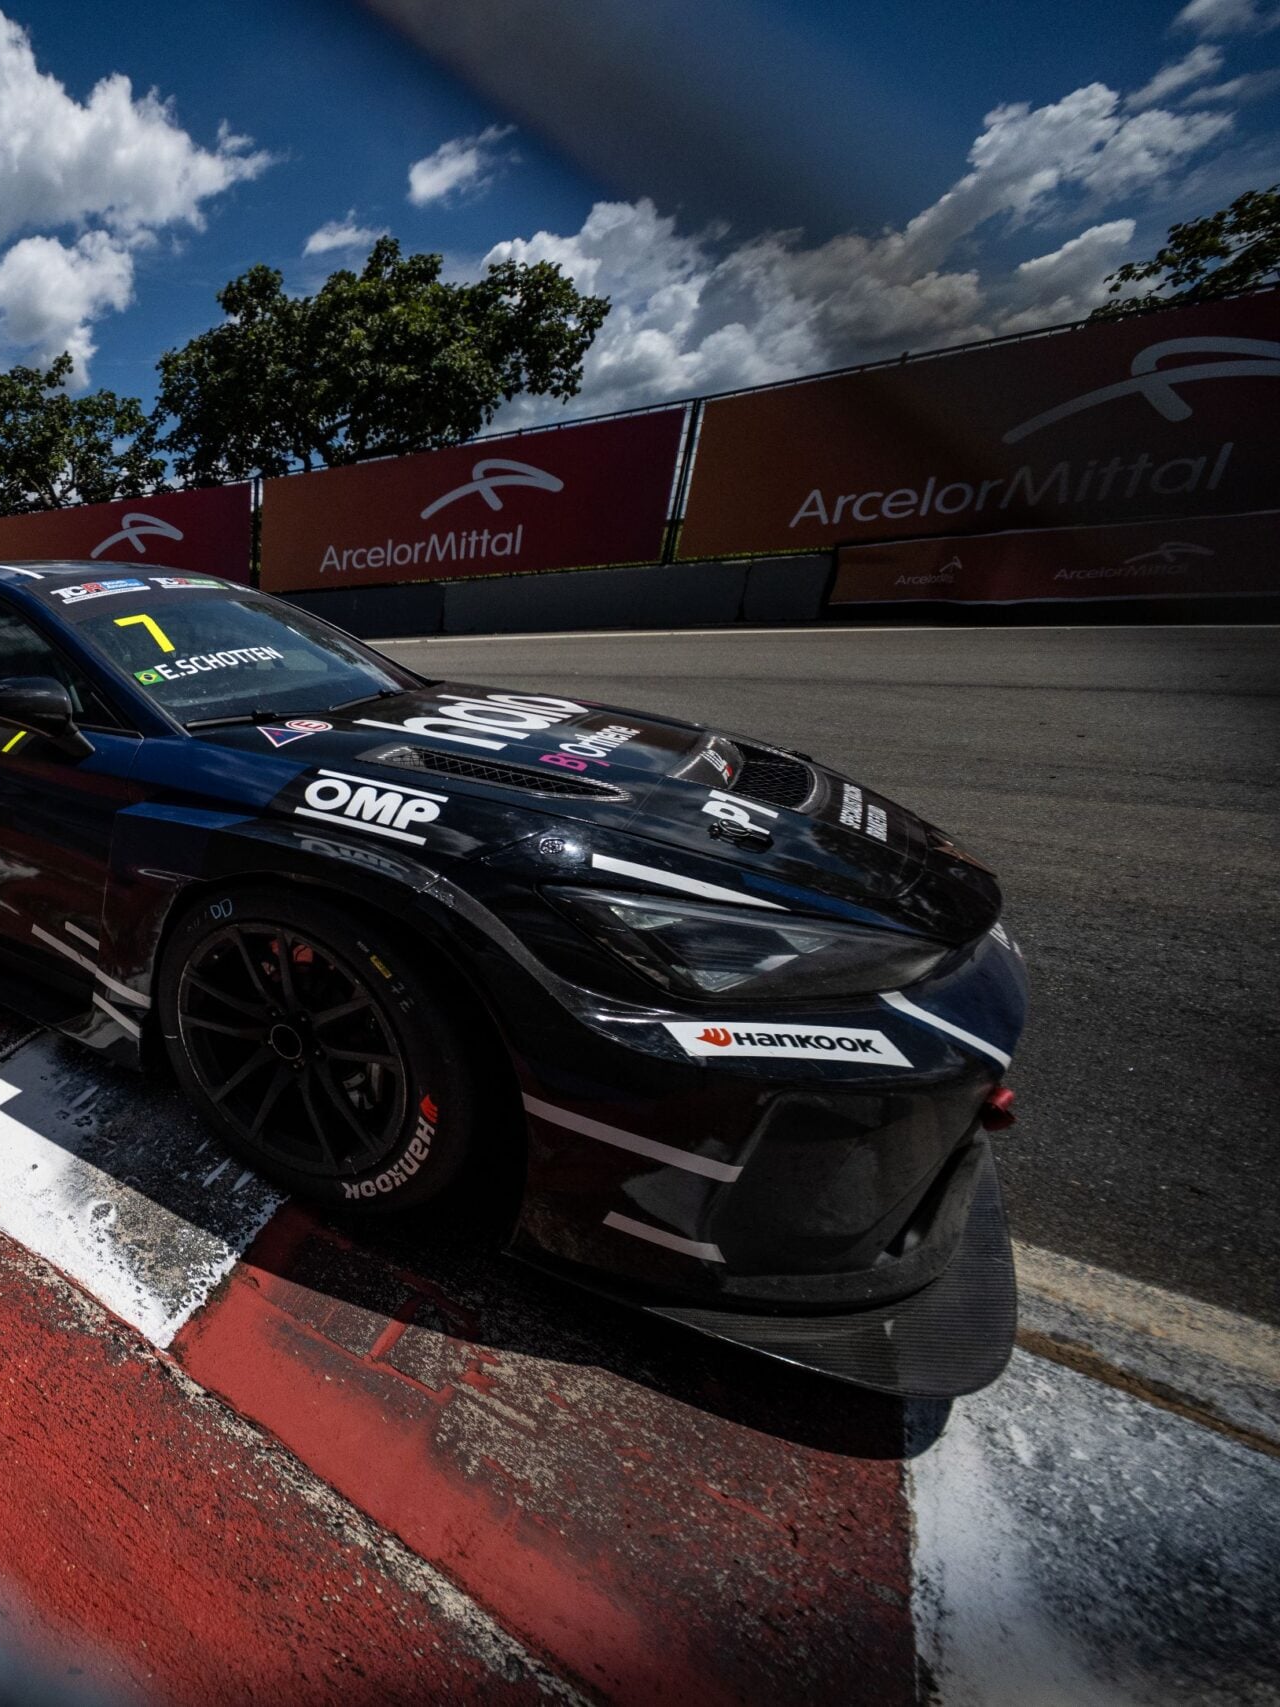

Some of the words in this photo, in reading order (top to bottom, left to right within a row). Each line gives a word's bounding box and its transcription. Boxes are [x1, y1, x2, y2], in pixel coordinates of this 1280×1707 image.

[788, 442, 1235, 529] ArcelorMittal
[320, 524, 523, 573] ArcelorMittal
[50, 582, 109, 599] TCR
[113, 614, 176, 653] 7
[305, 778, 441, 830] OMP
